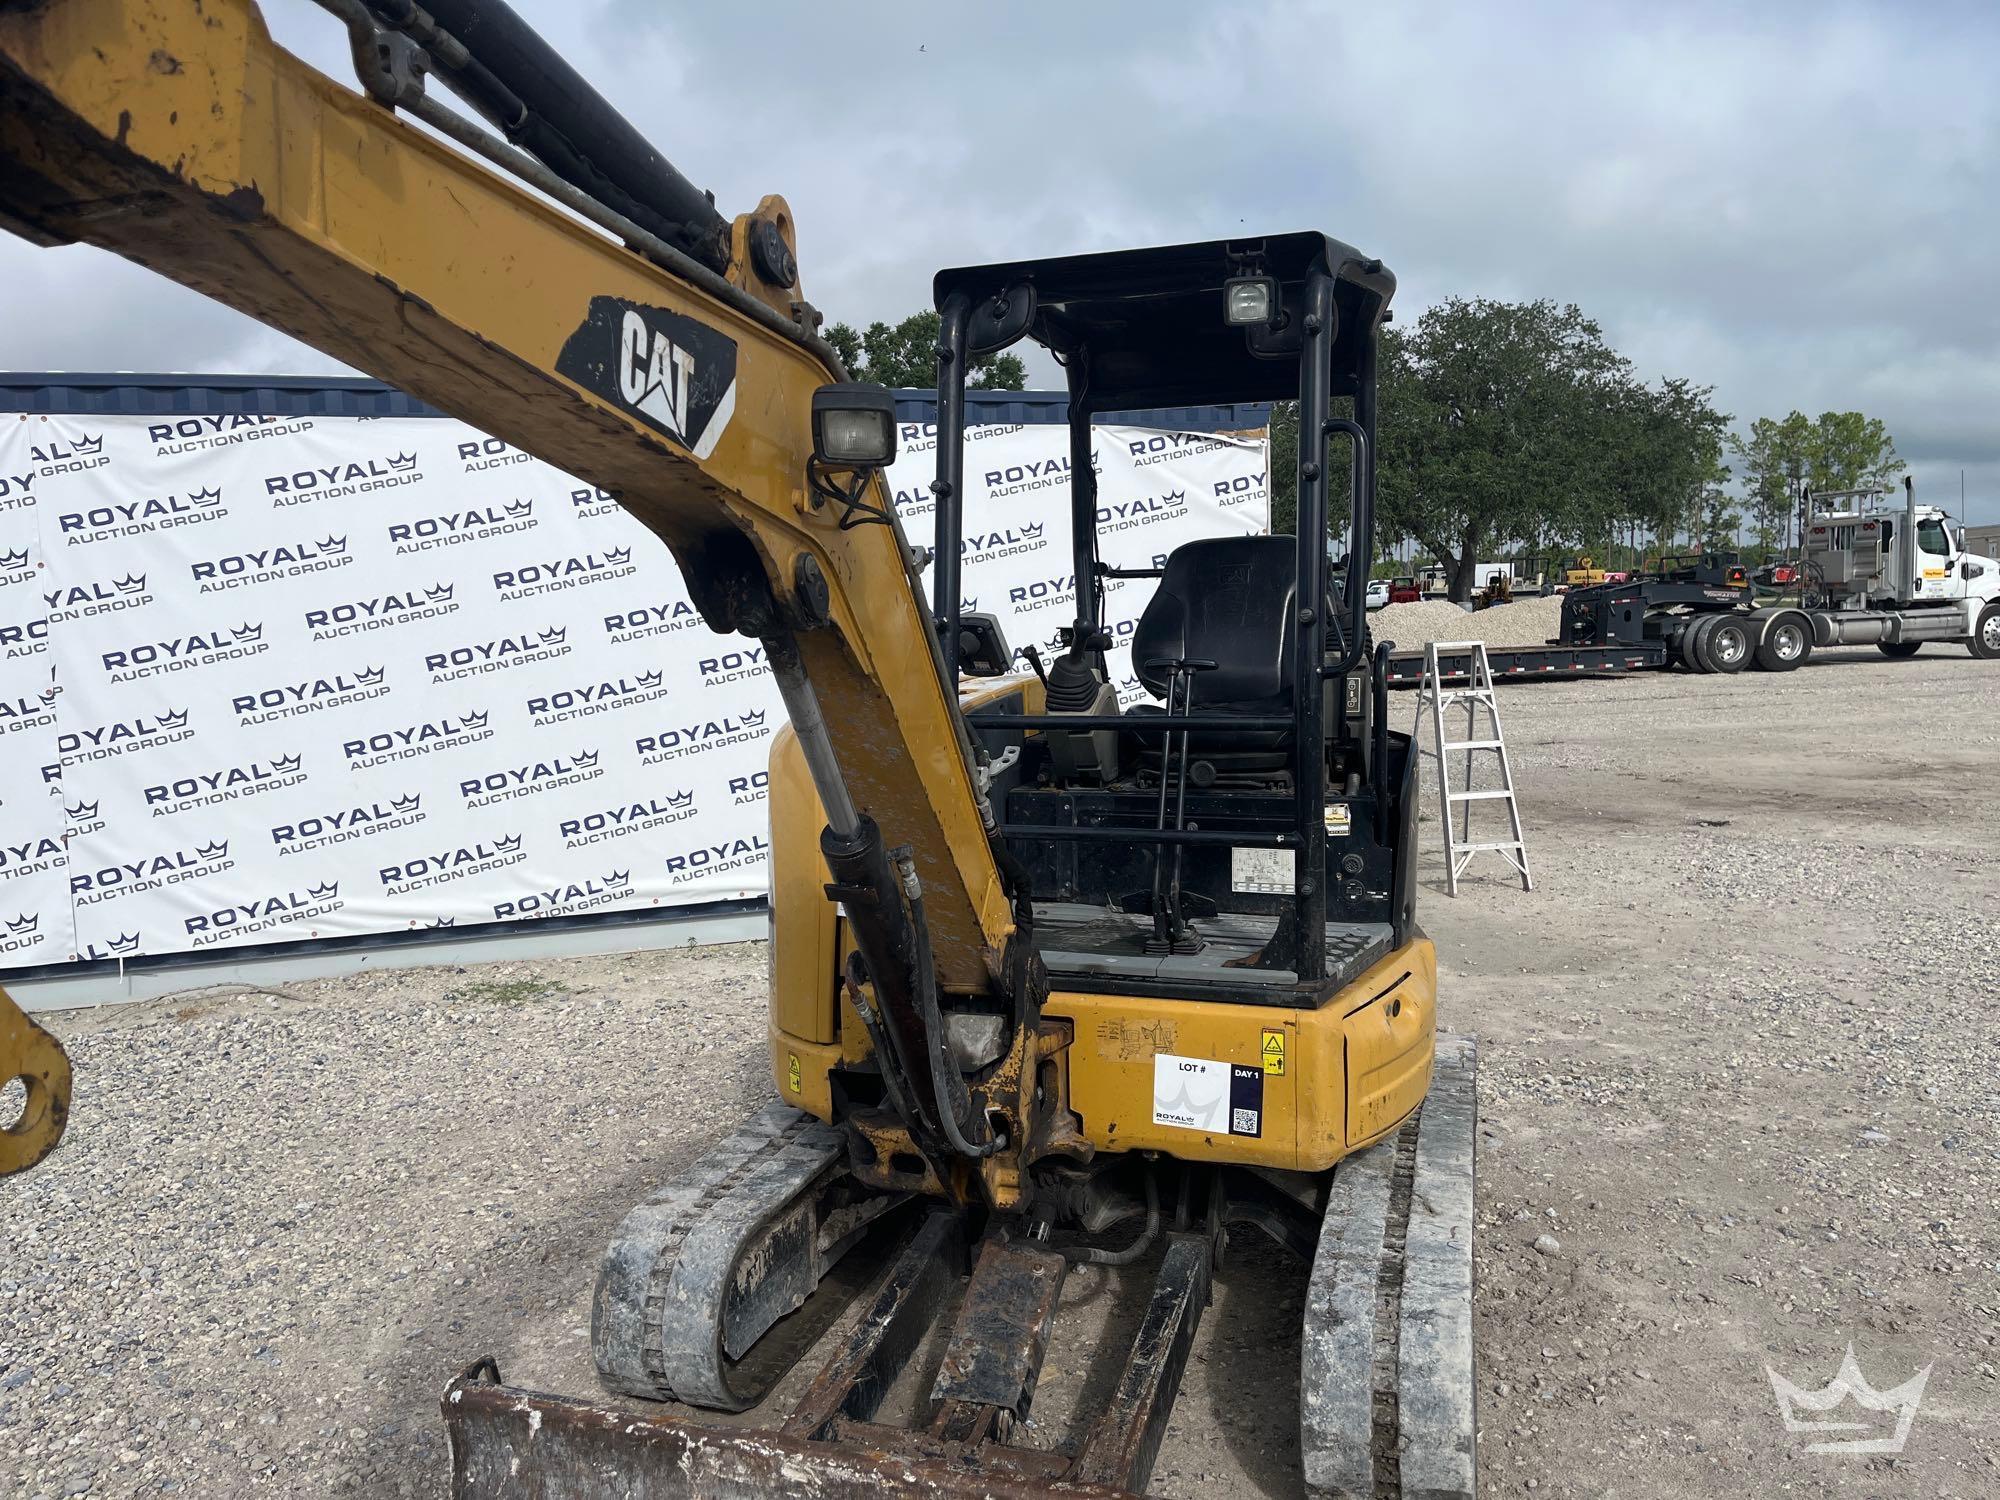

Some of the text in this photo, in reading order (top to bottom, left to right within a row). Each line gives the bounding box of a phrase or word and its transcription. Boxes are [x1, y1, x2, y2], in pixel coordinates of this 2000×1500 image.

[620, 310, 695, 437] CAT
[156, 421, 314, 457] AUCTION GROUP
[973, 424, 1024, 440] GROUP
[40, 456, 111, 477] GROUP
[264, 459, 389, 495] ROYAL
[1134, 448, 1193, 468] AUCTION
[273, 472, 424, 509] AUCTION GROUP
[990, 478, 1053, 499] AUCTION
[58, 495, 191, 533] ROYAL
[67, 508, 229, 547] AUCTION GROUP
[388, 507, 506, 543] ROYAL
[906, 503, 936, 516] GRO
[1096, 497, 1163, 523] OYAL
[1097, 507, 1188, 535] CTION GROUP
[395, 519, 539, 556] AUCTION GROUP
[962, 540, 1048, 566] TION GROUP
[190, 543, 318, 581] ROYAL
[199, 555, 354, 594] AUCTION GROUP
[493, 554, 605, 590] ROYAL
[500, 566, 637, 603] AUCTION GROUP
[83, 594, 154, 617] GROUP
[304, 591, 426, 629] ROYAL
[312, 603, 460, 642] AUCTION GROUP
[604, 601, 694, 633] ROYA
[101, 631, 233, 671] ROYAL
[610, 621, 683, 645] AUCTION
[110, 643, 270, 685] AUCTION GROUP
[424, 634, 540, 673] ROYAL
[432, 645, 572, 685] AUCTION GROUP
[699, 647, 763, 676] ROY
[231, 675, 356, 715] ROYAL
[240, 686, 391, 728] AUCTION GROUP
[527, 677, 638, 716] ROYAL
[533, 688, 668, 728] AUCTION GROUP
[125, 729, 195, 753] GROUP
[342, 719, 461, 759] ROYAL
[350, 729, 494, 772] AUCTION GROUP
[635, 717, 742, 755] ROYAL
[641, 727, 770, 767] AUCTION GROUP
[143, 763, 272, 806] ROYAL
[152, 773, 308, 818] AUCTION GROUP
[459, 757, 573, 798] ROYAL
[467, 768, 604, 810] AUCTION GROUP
[271, 803, 393, 845] ROYAL
[279, 812, 427, 857] AUCTION GROUP
[559, 799, 668, 838] ROYAL
[566, 808, 698, 850] AUCTION GROUP
[71, 851, 198, 894] ROYAL
[379, 843, 495, 885] ROYAL
[386, 852, 527, 897] AUCTION GROUP
[672, 858, 742, 885] AUCTION
[76, 860, 235, 908] AUCTION GROUP
[493, 880, 604, 920] ROYAL
[577, 888, 635, 910] GROUP
[184, 892, 309, 935] ROYAL
[192, 900, 344, 948] AUCTION GROUP
[1179, 1062, 1206, 1073] LOT #
[1234, 1069, 1253, 1078] DAY
[1156, 1112, 1187, 1122] ROYAL
